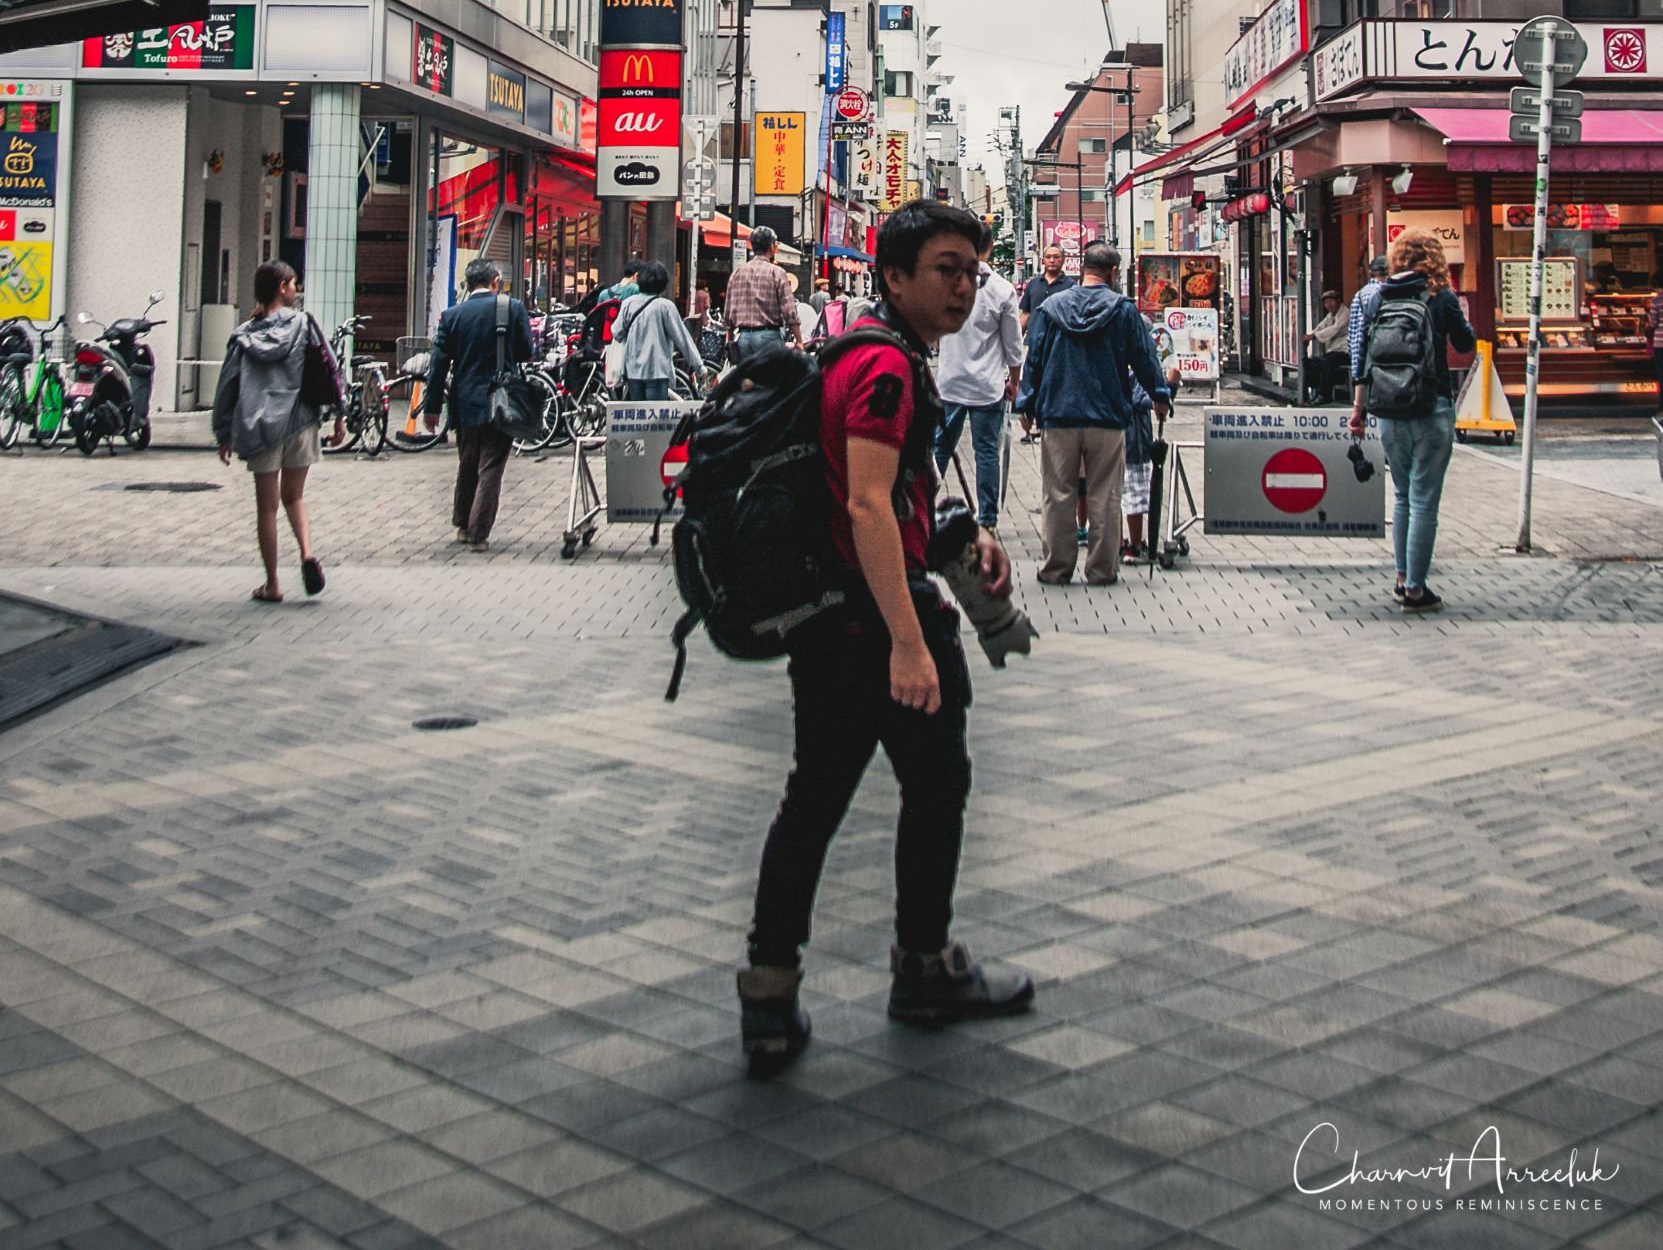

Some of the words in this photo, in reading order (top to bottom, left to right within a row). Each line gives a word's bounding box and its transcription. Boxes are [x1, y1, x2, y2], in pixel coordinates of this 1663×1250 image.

[144, 53, 178, 63] Tofuro
[490, 72, 523, 114] TSUTAYA
[614, 112, 664, 133] au
[763, 117, 798, 129] 福しん
[844, 126, 867, 134] ANN
[774, 131, 786, 190] 中華・定食
[886, 138, 902, 208] 大人のオモチャ
[1178, 359, 1208, 371] 150円
[1212, 414, 1285, 427] 車両進入禁止
[1294, 415, 1328, 428] 10:00
